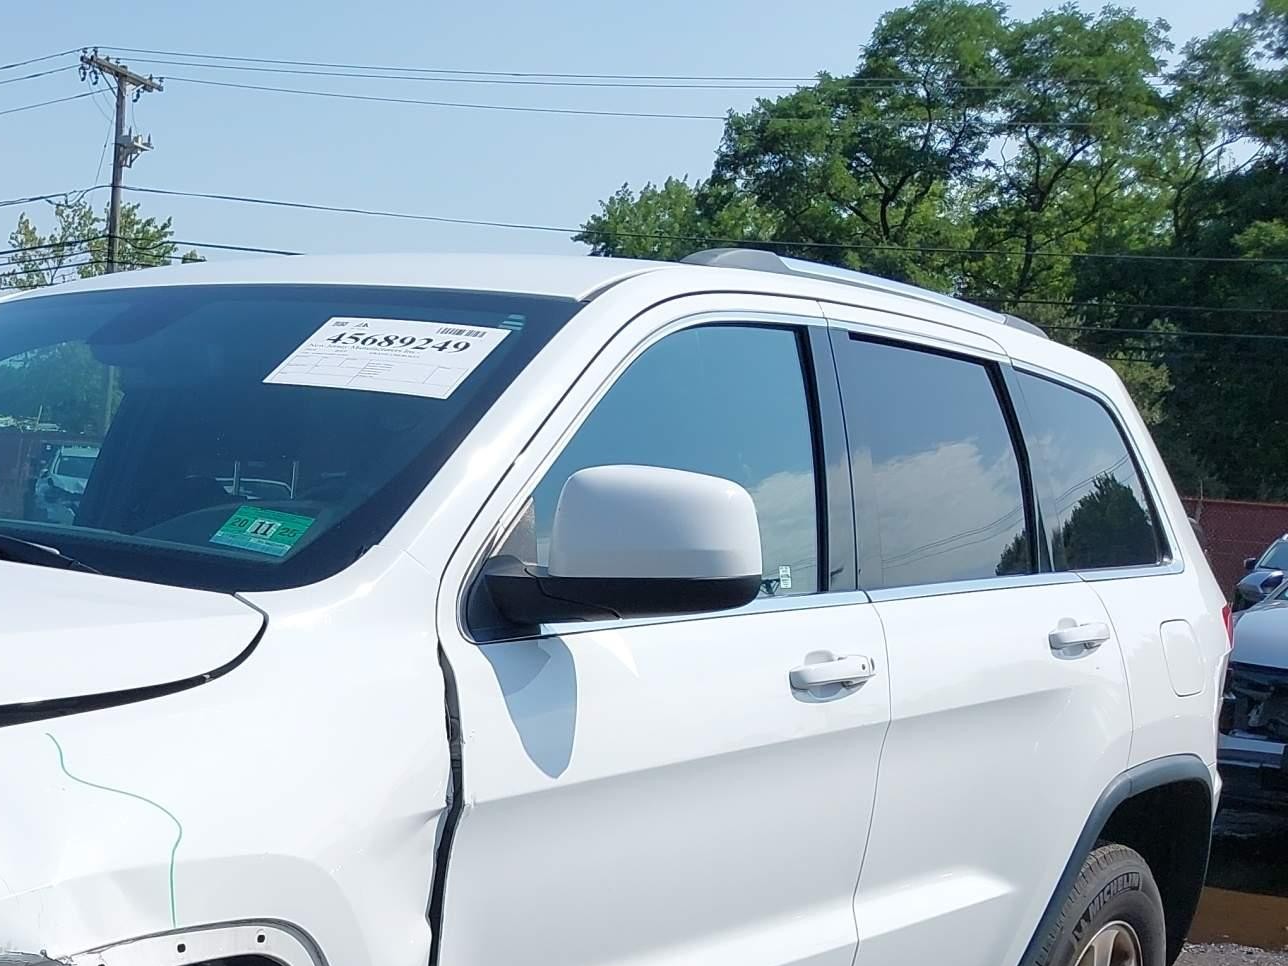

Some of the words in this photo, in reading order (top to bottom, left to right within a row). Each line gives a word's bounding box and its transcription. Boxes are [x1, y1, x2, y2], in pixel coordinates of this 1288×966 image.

[325, 331, 471, 353] 45689249
[231, 518, 249, 529] 20
[251, 521, 275, 536] 11
[1088, 872, 1140, 920] MICHELIN
